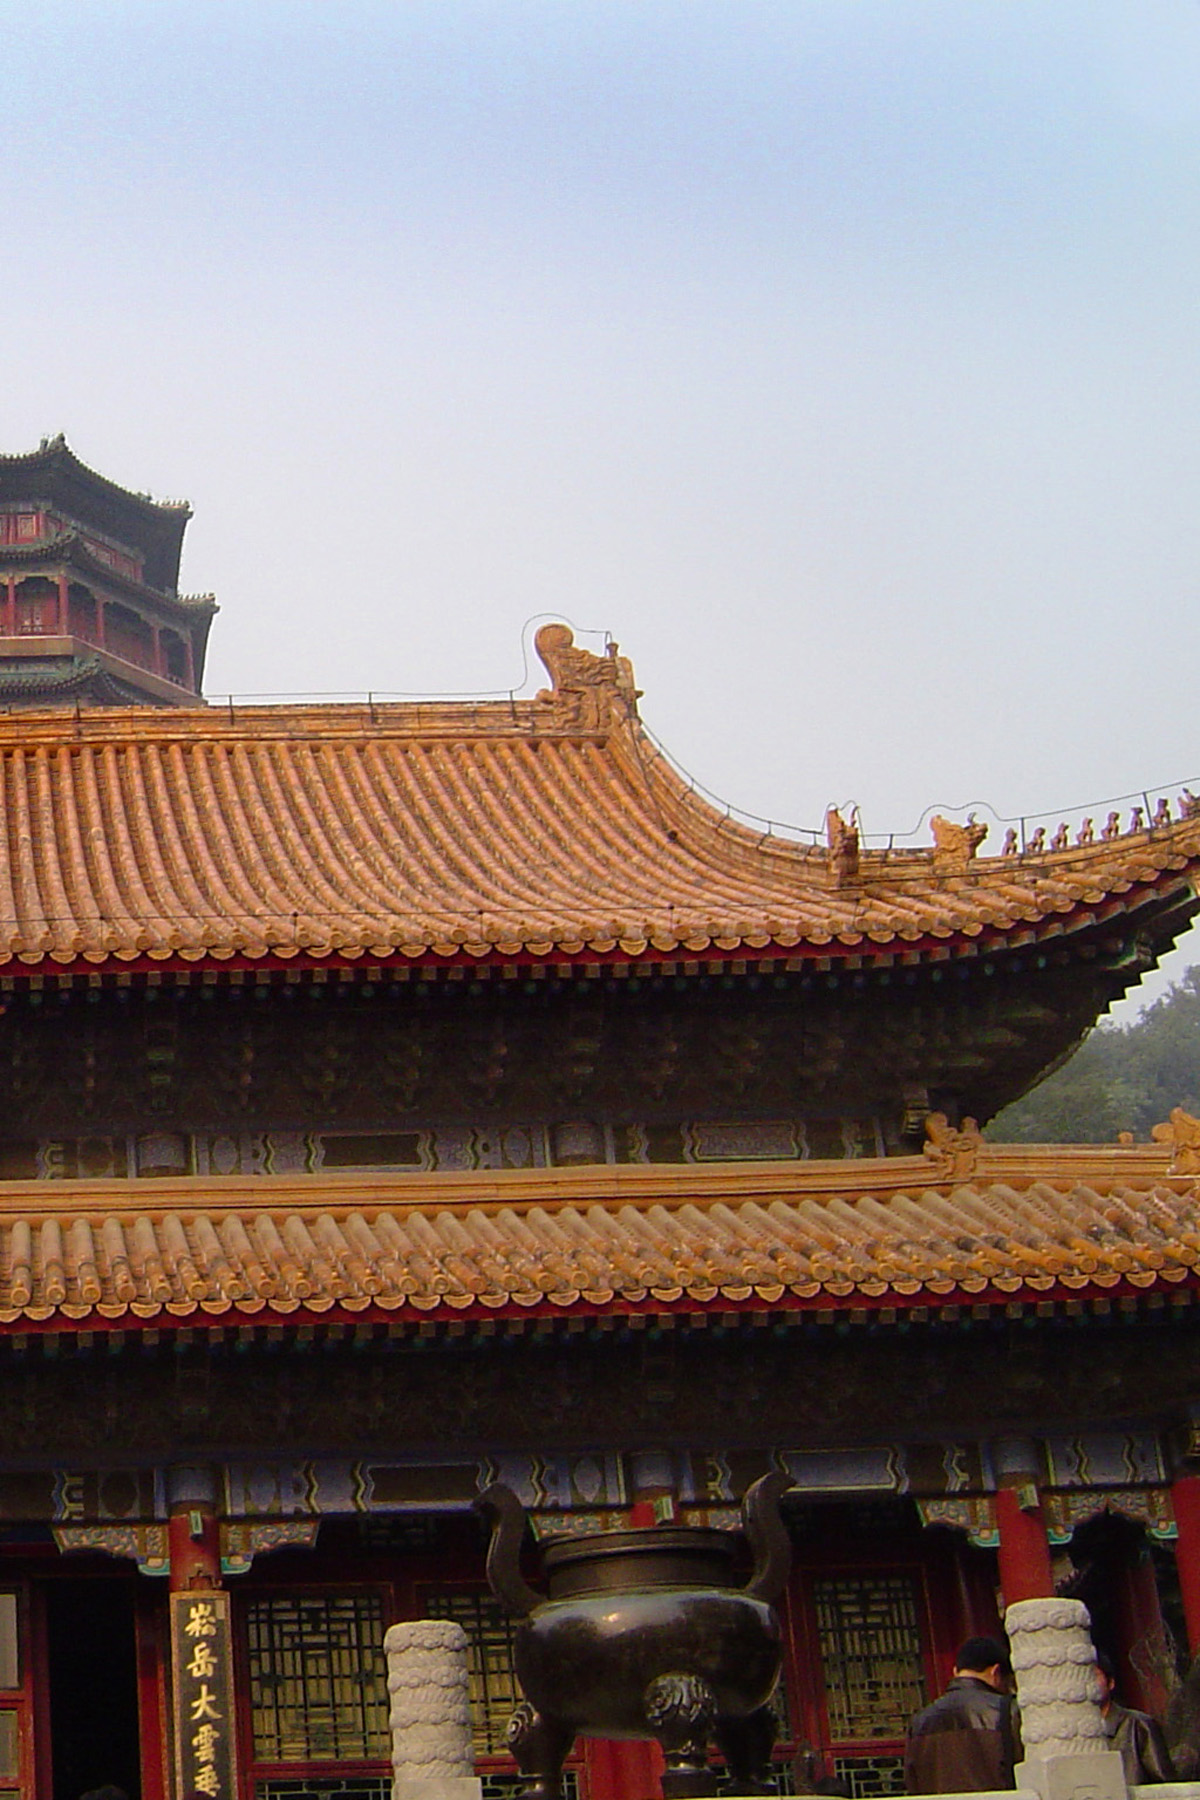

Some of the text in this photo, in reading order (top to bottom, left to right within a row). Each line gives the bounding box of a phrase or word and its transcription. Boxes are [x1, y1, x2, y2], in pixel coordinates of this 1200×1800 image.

[184, 1602, 222, 1797] 崧岳大雲垂
